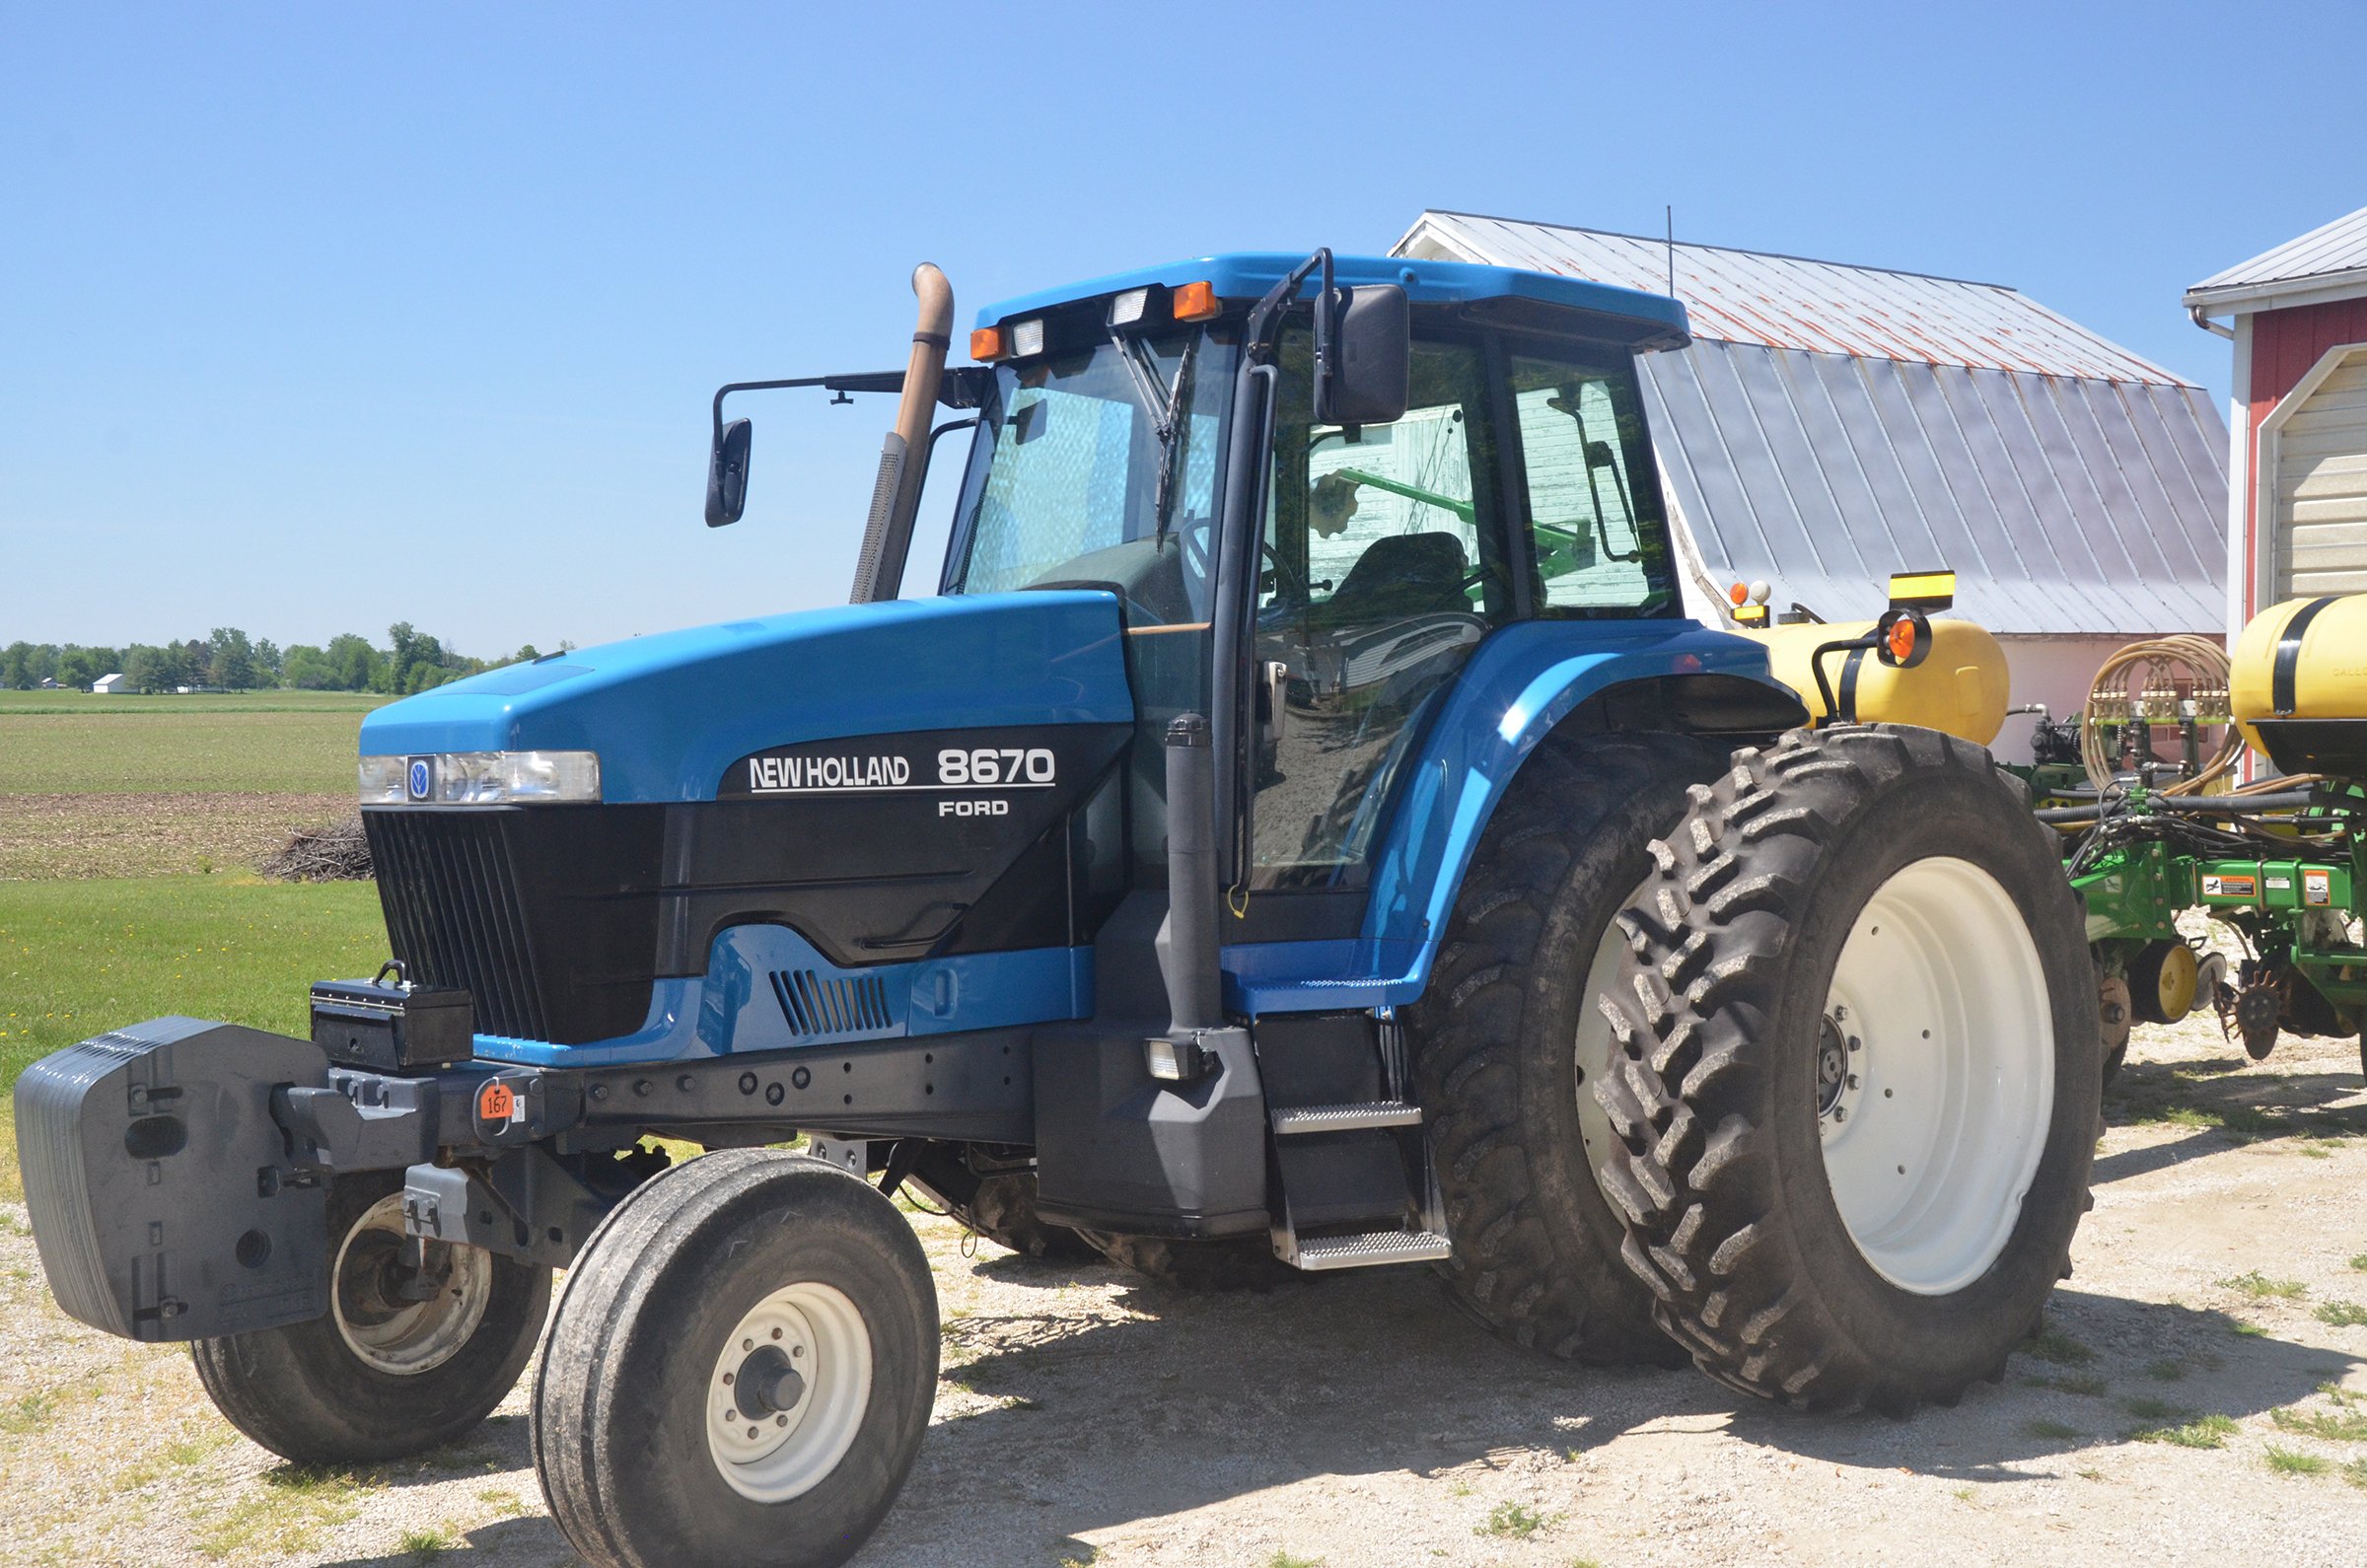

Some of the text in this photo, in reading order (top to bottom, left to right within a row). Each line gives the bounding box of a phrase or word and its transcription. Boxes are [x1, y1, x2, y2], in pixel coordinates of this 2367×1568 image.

[750, 748, 1055, 788] NEW HOLLAND 8670
[938, 800, 1009, 817] FORD
[488, 1096, 507, 1113] 167
